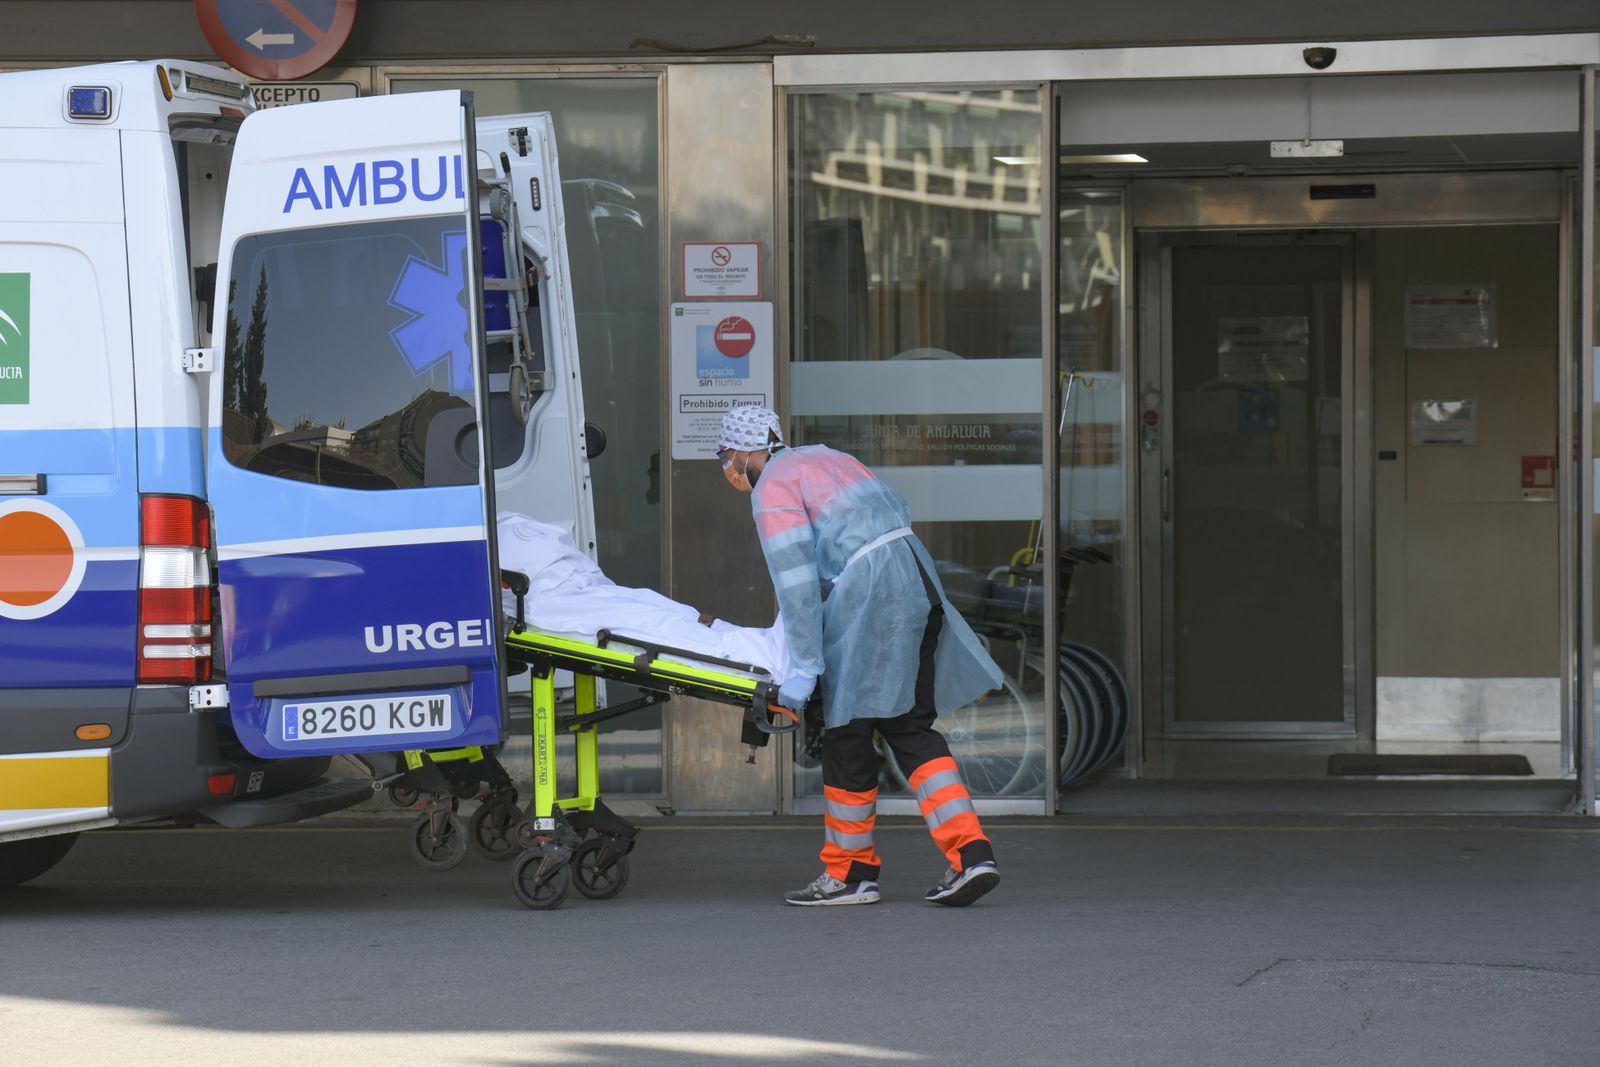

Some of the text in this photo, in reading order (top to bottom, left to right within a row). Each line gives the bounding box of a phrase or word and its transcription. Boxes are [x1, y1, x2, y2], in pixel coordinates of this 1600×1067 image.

[699, 366, 735, 378] espacio
[699, 378, 742, 387] sin humo
[683, 399, 729, 408] Prohibido
[906, 424, 921, 438] DE
[364, 619, 491, 654] URGE
[302, 699, 445, 735] 8260 KGW
[288, 726, 295, 735] E
